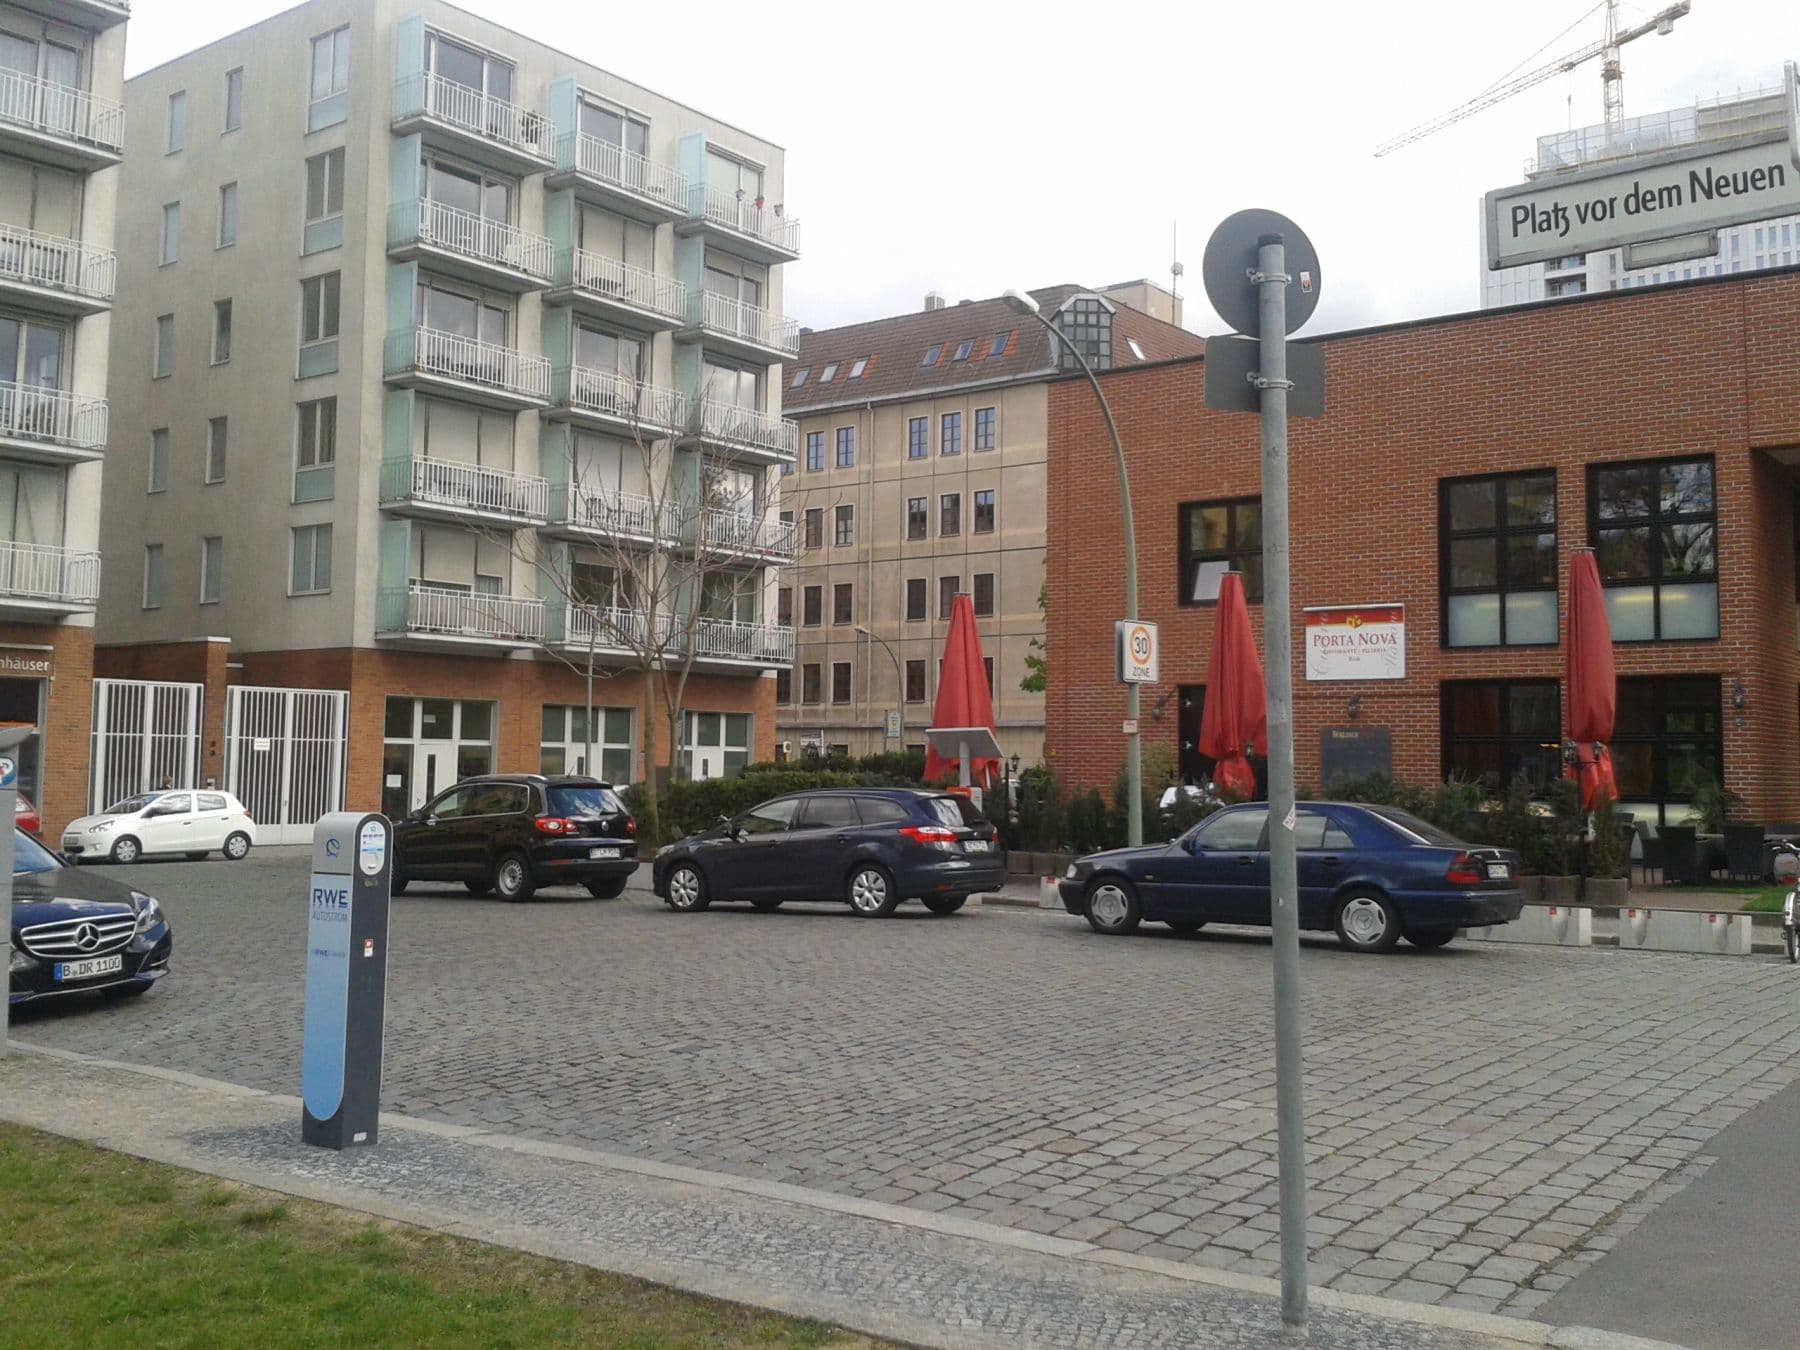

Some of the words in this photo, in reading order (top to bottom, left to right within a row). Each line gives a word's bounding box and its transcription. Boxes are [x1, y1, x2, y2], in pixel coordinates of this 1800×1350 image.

[1511, 202, 1570, 238] Platz
[1575, 195, 1617, 225] vor
[1623, 181, 1682, 216] dem
[1689, 163, 1785, 203] Neuen
[1134, 636, 1148, 655] 30
[1313, 634, 1355, 648] PORTA
[1358, 632, 1398, 646] NOVA
[1132, 666, 1151, 678] ZONE
[313, 888, 349, 906] RWE
[312, 910, 348, 923] AUTOSTROM
[63, 965, 71, 977] B
[79, 962, 94, 975] DR
